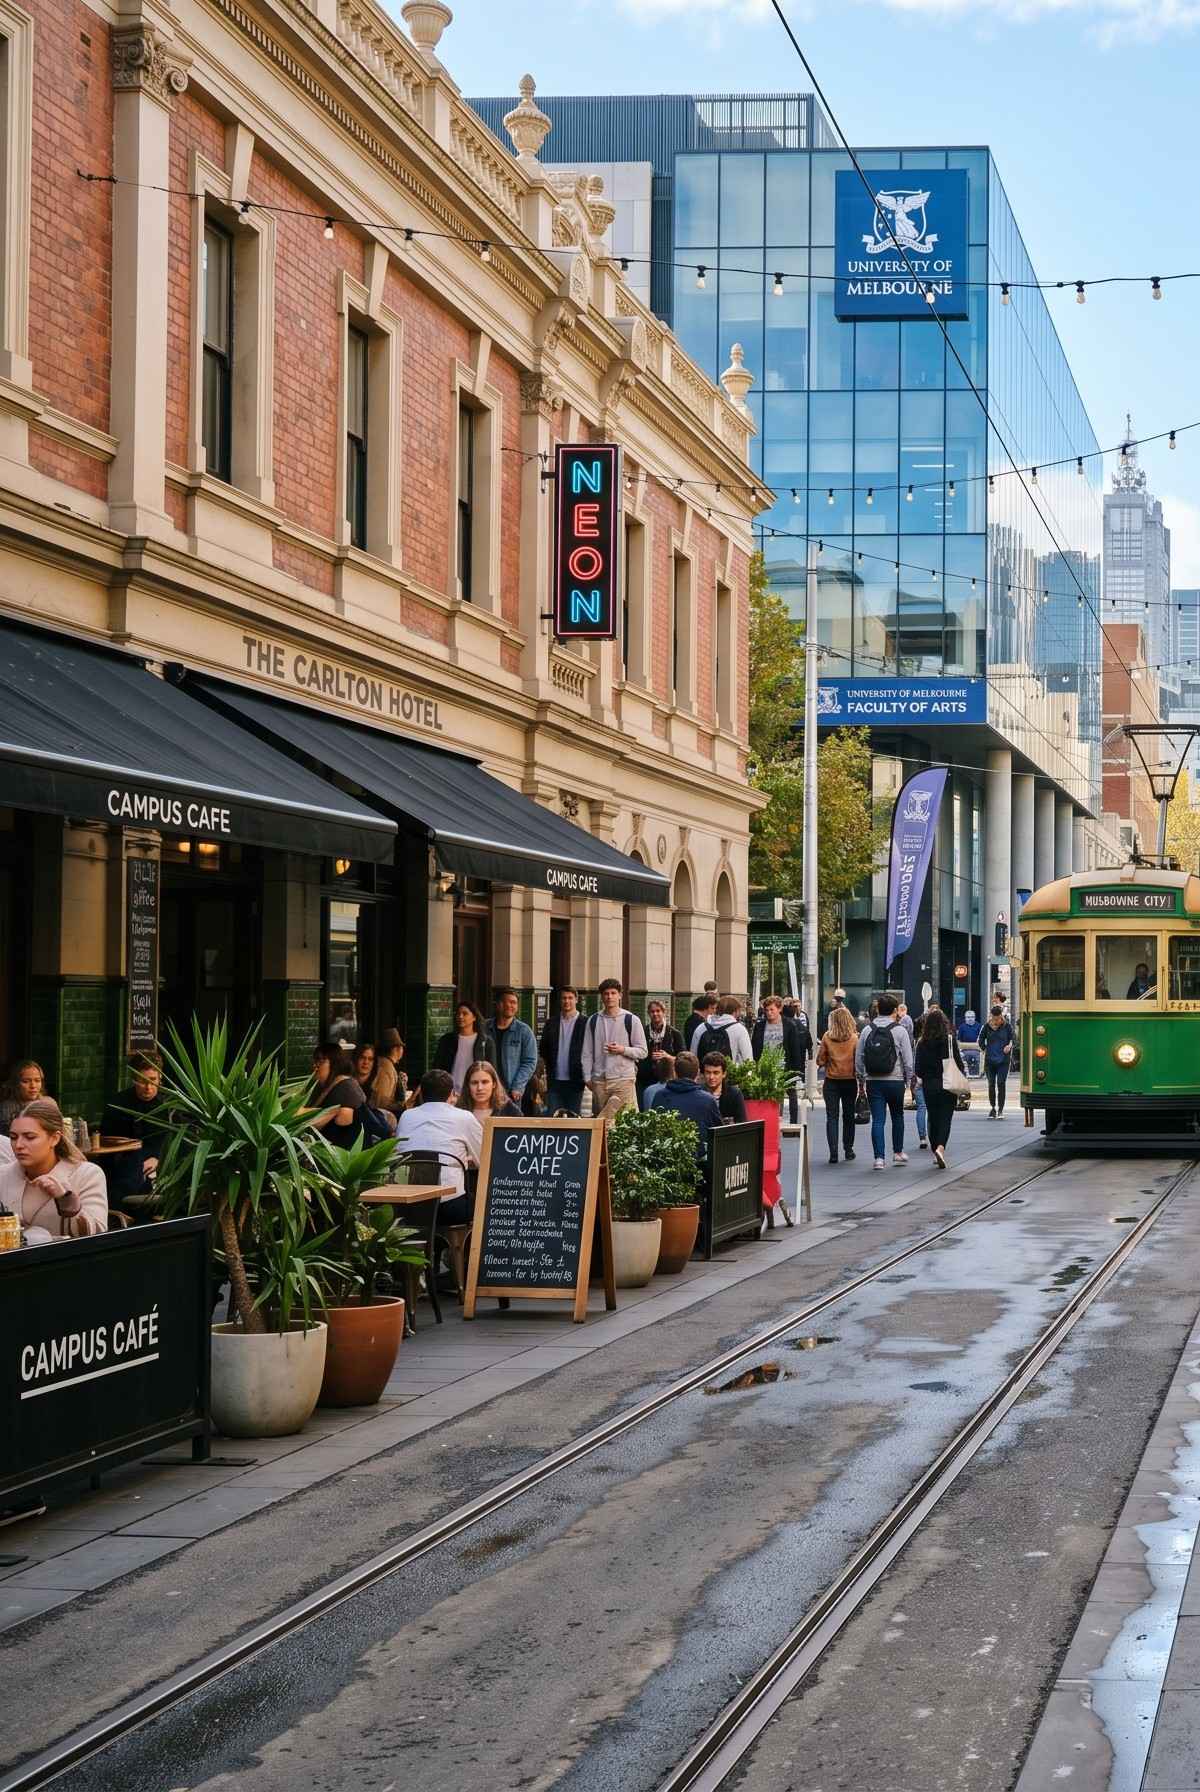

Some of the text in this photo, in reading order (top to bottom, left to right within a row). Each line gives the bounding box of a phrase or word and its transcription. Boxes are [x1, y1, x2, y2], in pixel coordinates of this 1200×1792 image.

[848, 260, 952, 272] UNIVERSTY OF
[569, 461, 602, 622] NEON
[242, 635, 442, 730] THE CARLTON HOTEL
[847, 689, 897, 698] UNIVERSITY
[899, 689, 911, 698] OF
[847, 702, 967, 713] FACULTY OF ARTS
[107, 790, 231, 833] CAMPUS CAFE
[546, 869, 598, 893] CAMPUS CAFE
[1144, 895, 1166, 907] CITY
[504, 1135, 580, 1155] CAMPUS
[517, 1156, 563, 1175] CAFE
[21, 1303, 159, 1381] CAMPUS CAFÉ
